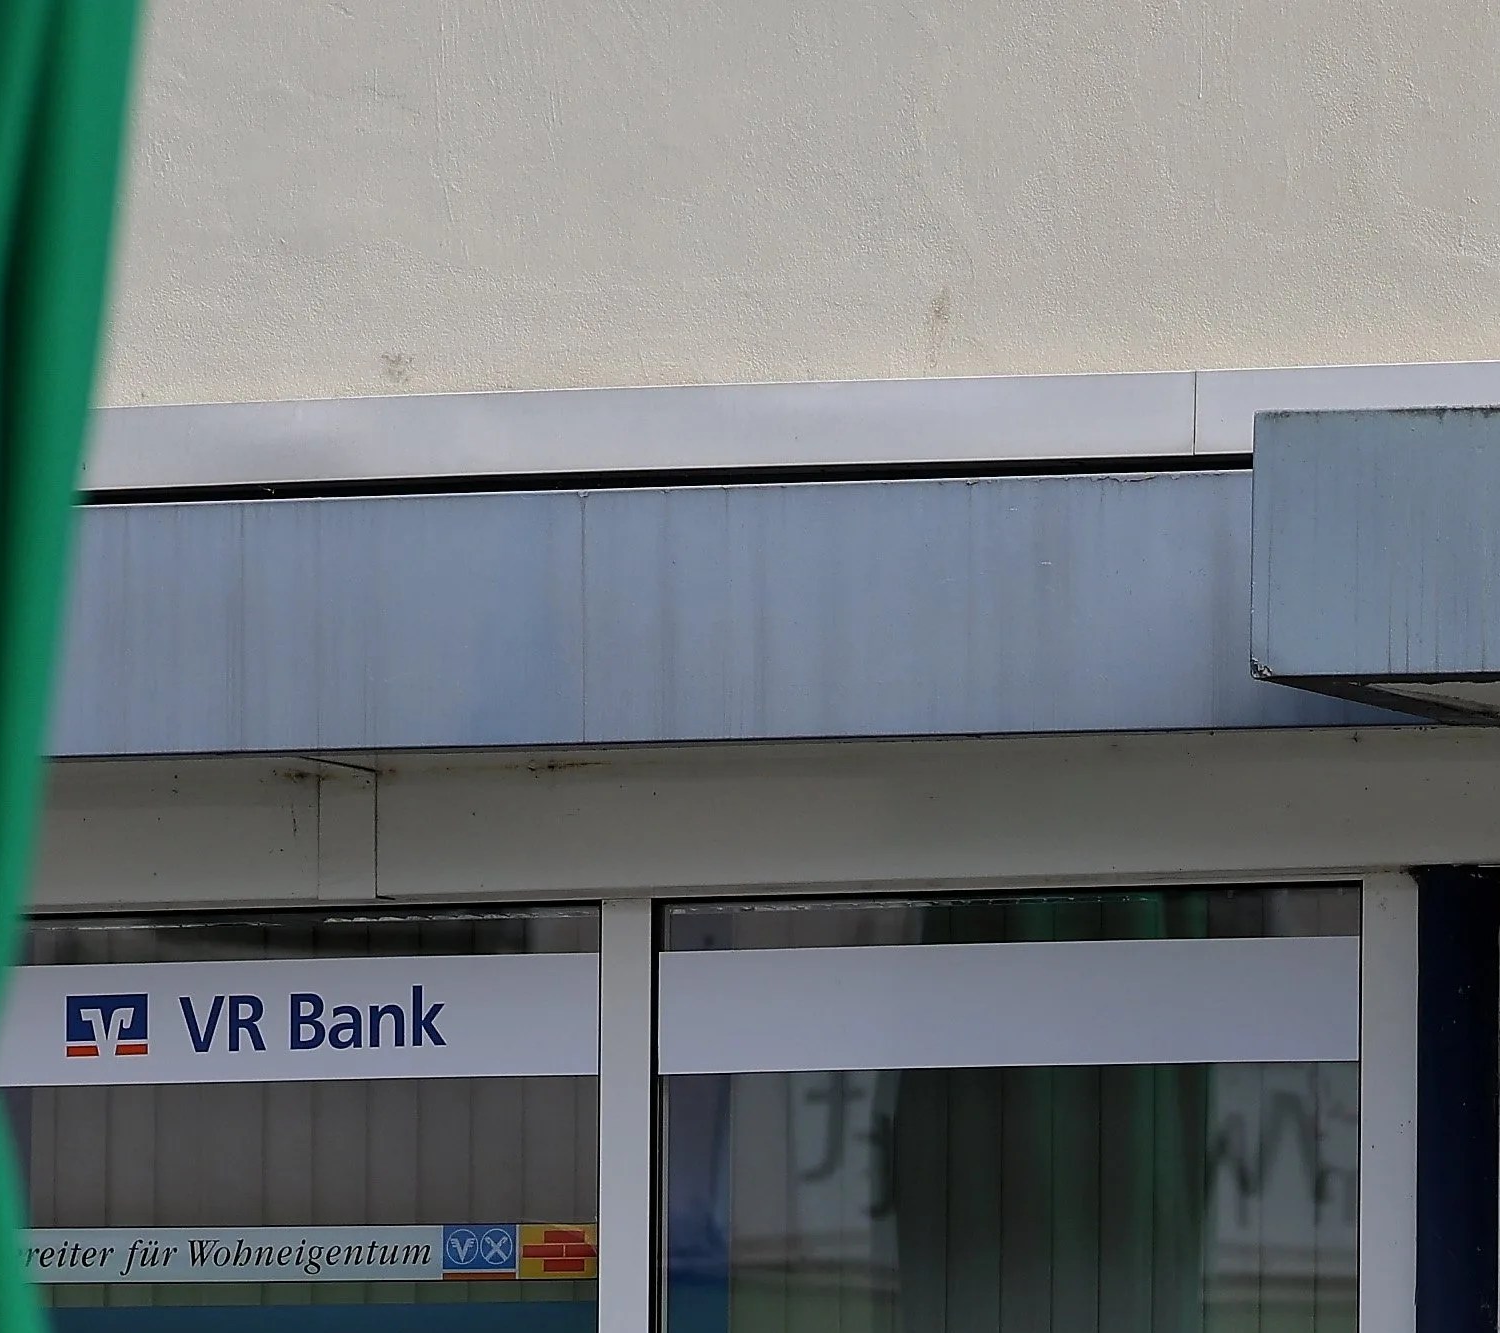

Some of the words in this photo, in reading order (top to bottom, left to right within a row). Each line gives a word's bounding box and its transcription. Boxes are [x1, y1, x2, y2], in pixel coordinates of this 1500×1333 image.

[179, 995, 266, 1053] VR
[290, 984, 447, 1050] Bank
[18, 1240, 115, 1268] reiter
[119, 1238, 177, 1276] für
[187, 1237, 431, 1276] Wohneigentum
